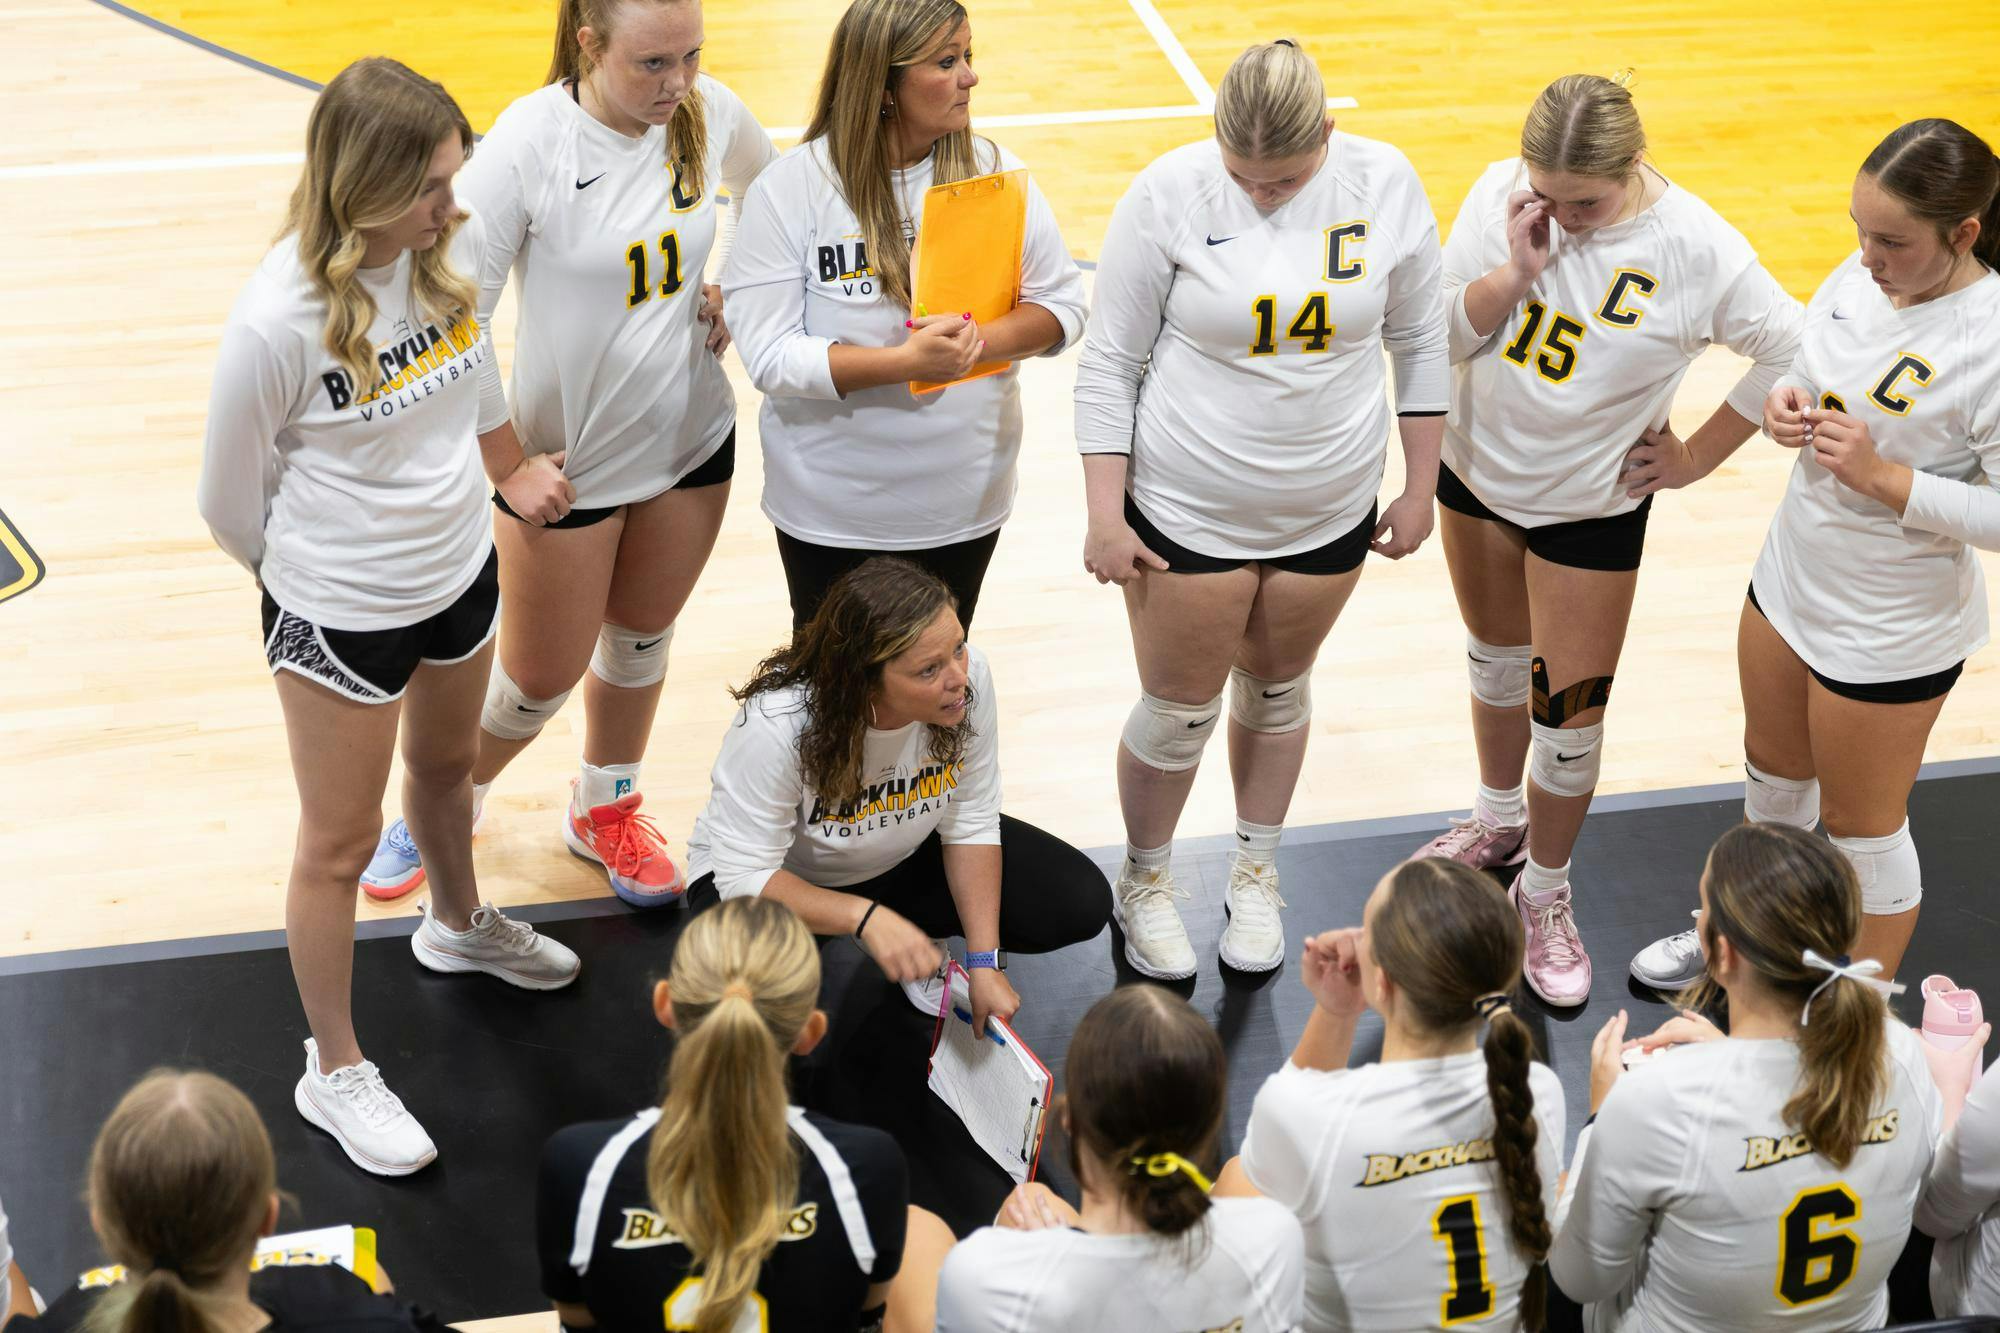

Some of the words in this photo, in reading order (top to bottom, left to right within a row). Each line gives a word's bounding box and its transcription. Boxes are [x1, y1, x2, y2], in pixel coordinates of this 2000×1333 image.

[625, 229, 684, 309] 11
[1322, 219, 1369, 284] C
[1247, 291, 1337, 358] 14
[1593, 266, 1660, 329] C
[1501, 300, 1587, 385] 15
[1866, 350, 1937, 416] C
[1431, 1192, 1497, 1328] 1
[1773, 1180, 1863, 1308] 6
